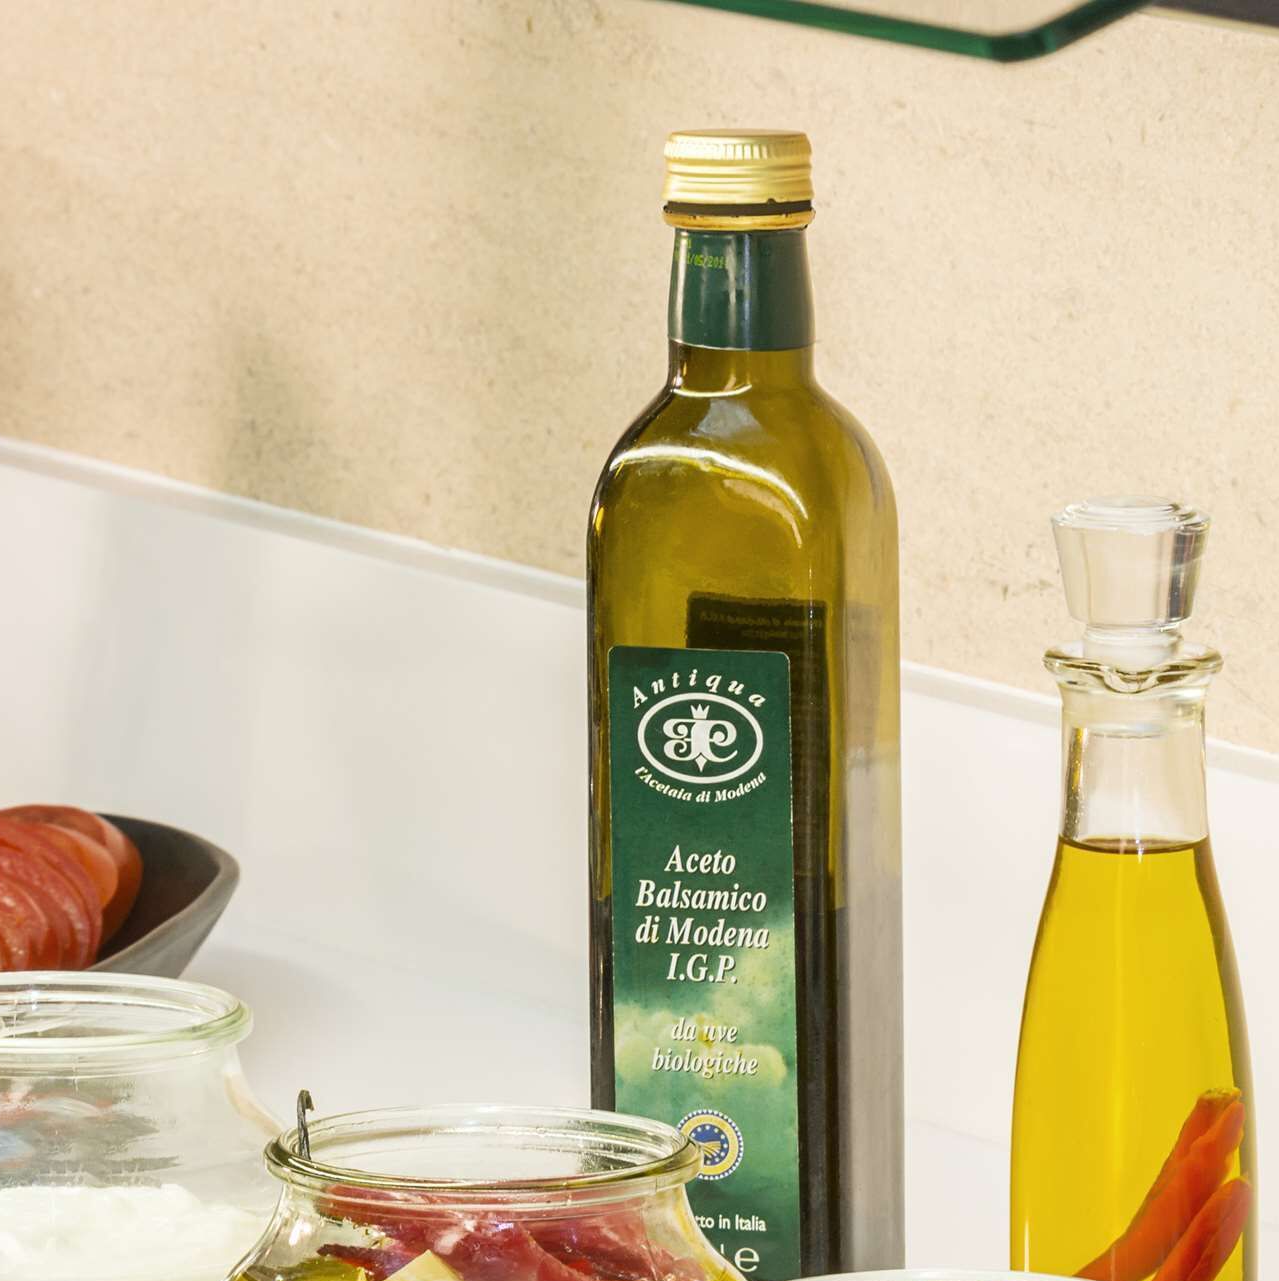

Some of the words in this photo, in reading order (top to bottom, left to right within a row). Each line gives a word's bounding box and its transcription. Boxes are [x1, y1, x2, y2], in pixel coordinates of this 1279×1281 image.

[633, 669, 766, 708] Antiqua
[634, 766, 693, 801] l'Acetaia
[695, 790, 711, 802] di
[714, 771, 767, 802] Modena
[664, 845, 736, 874] Aceto
[635, 879, 767, 912] Balsamico
[635, 916, 660, 944] di
[665, 917, 770, 949] Modena
[667, 953, 738, 984] I.G.P.
[671, 1017, 697, 1041] da
[703, 1025, 738, 1043] uve
[651, 1047, 759, 1079] biologiche
[718, 1214, 731, 1230] in
[735, 1213, 767, 1232] Italia
